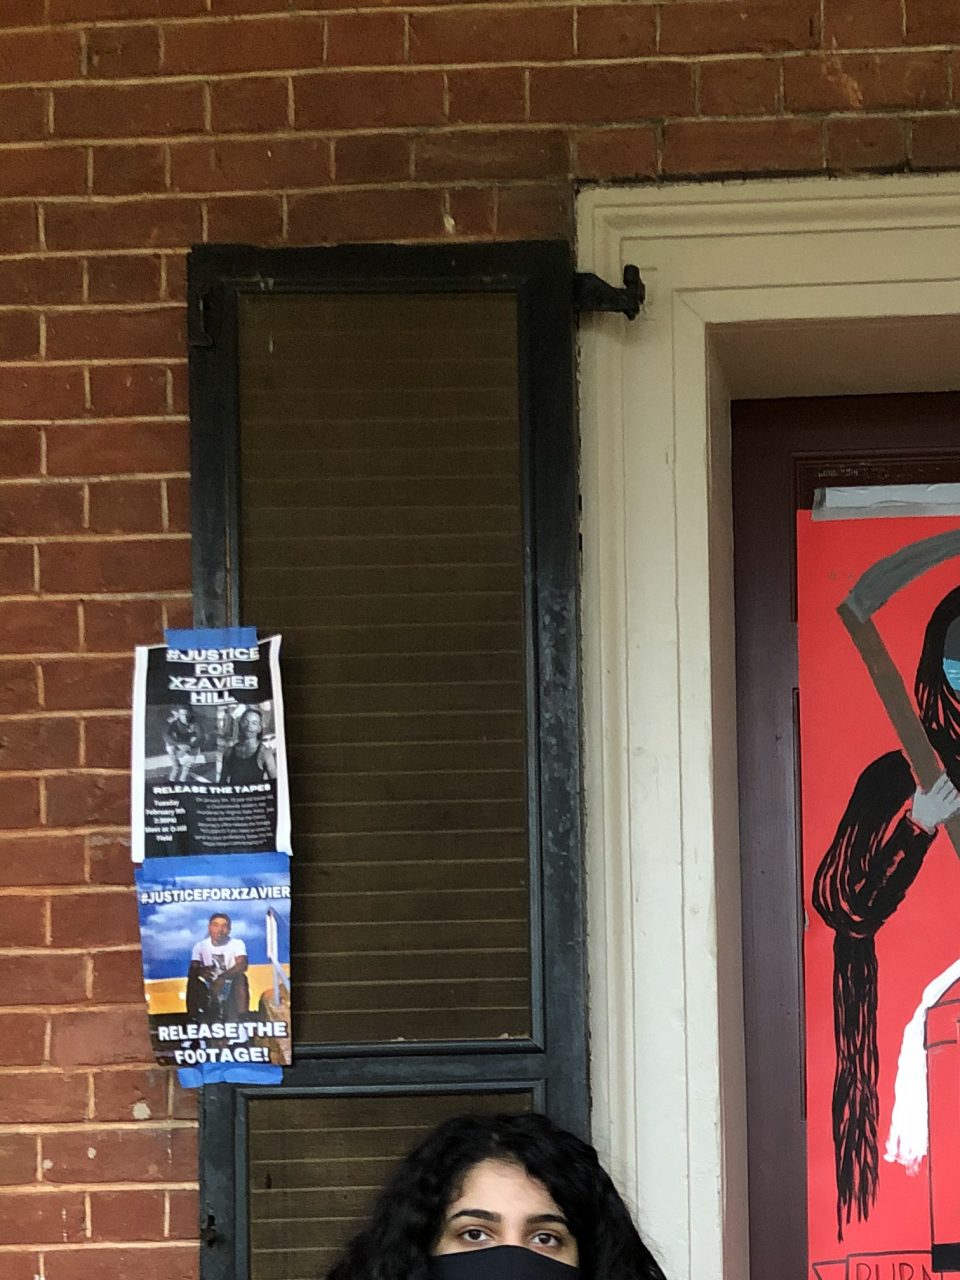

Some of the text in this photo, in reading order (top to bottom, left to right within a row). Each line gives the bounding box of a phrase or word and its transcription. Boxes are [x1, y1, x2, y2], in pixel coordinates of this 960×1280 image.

[166, 647, 260, 662] #JUSTICE
[195, 662, 235, 677] FOR
[168, 675, 259, 689] XZAVIER
[190, 690, 237, 704] HILL
[153, 784, 271, 795] RELEASE THE TAPES
[141, 886, 291, 905] #JUSTICEFORXZAVIER
[158, 1021, 287, 1041] RELEASE THE
[174, 1047, 270, 1065] FOOTAGE!
